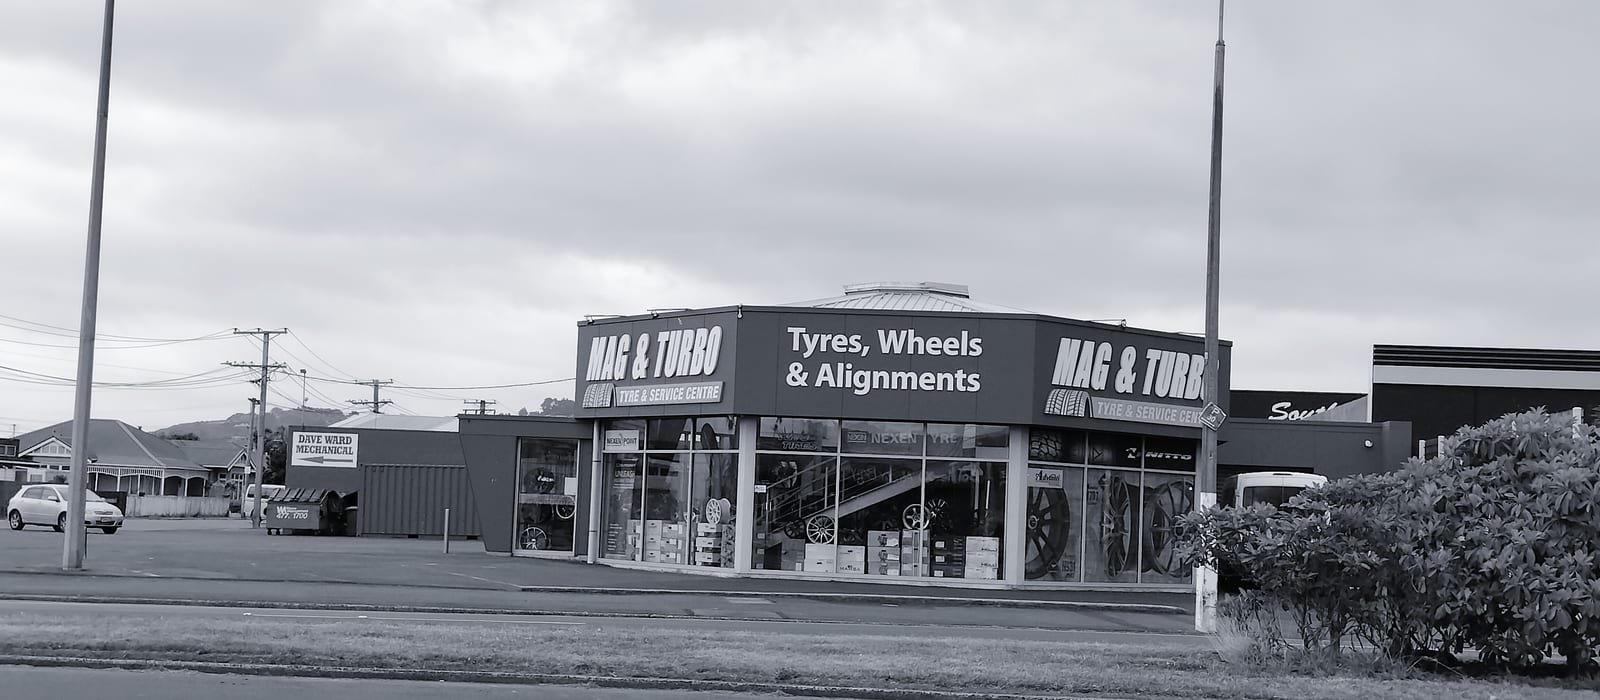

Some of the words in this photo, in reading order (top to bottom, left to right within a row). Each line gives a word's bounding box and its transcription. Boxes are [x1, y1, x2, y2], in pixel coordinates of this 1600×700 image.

[585, 333, 632, 381] MAG
[632, 333, 650, 380] &
[654, 325, 723, 378] TURBO
[787, 327, 870, 358] Tyres,
[877, 329, 983, 356] Wheels
[785, 362, 809, 387] &
[814, 362, 981, 395] Alignments
[1051, 337, 1112, 391] MAG
[1114, 346, 1137, 394] &
[1142, 348, 1208, 400] TURB
[619, 389, 640, 403] TYRE
[641, 388, 648, 401] &
[650, 387, 684, 402] SERVICE
[685, 385, 719, 400] CENTRE
[1097, 401, 1122, 417] TYRE
[1125, 405, 1135, 417] &
[1136, 405, 1177, 422] SERVICE
[298, 435, 322, 444] DAVE
[324, 436, 352, 445] WARD
[871, 432, 917, 444] NEXEN
[296, 445, 353, 455] MECHANICAL
